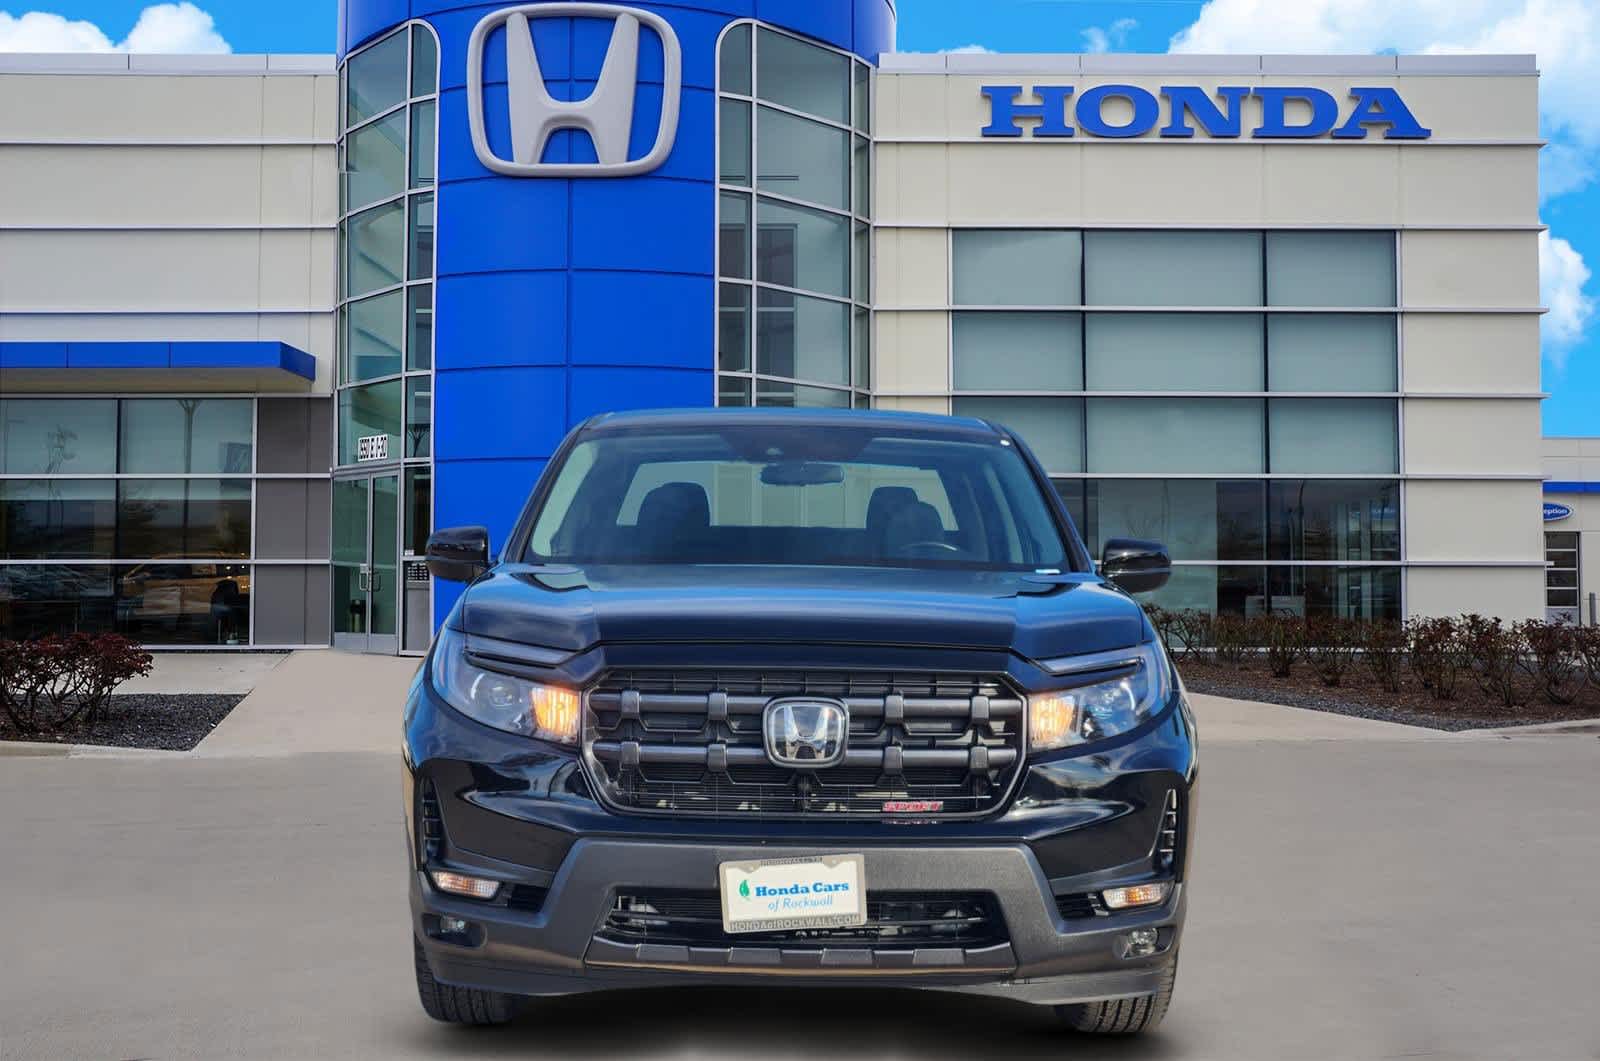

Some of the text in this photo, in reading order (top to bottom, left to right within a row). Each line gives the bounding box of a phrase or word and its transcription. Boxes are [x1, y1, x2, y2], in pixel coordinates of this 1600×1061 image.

[981, 84, 1432, 139] HONDA
[883, 801, 944, 812] SPORT
[755, 881, 849, 897] Honda Cars
[768, 895, 833, 912] of Rockwall
